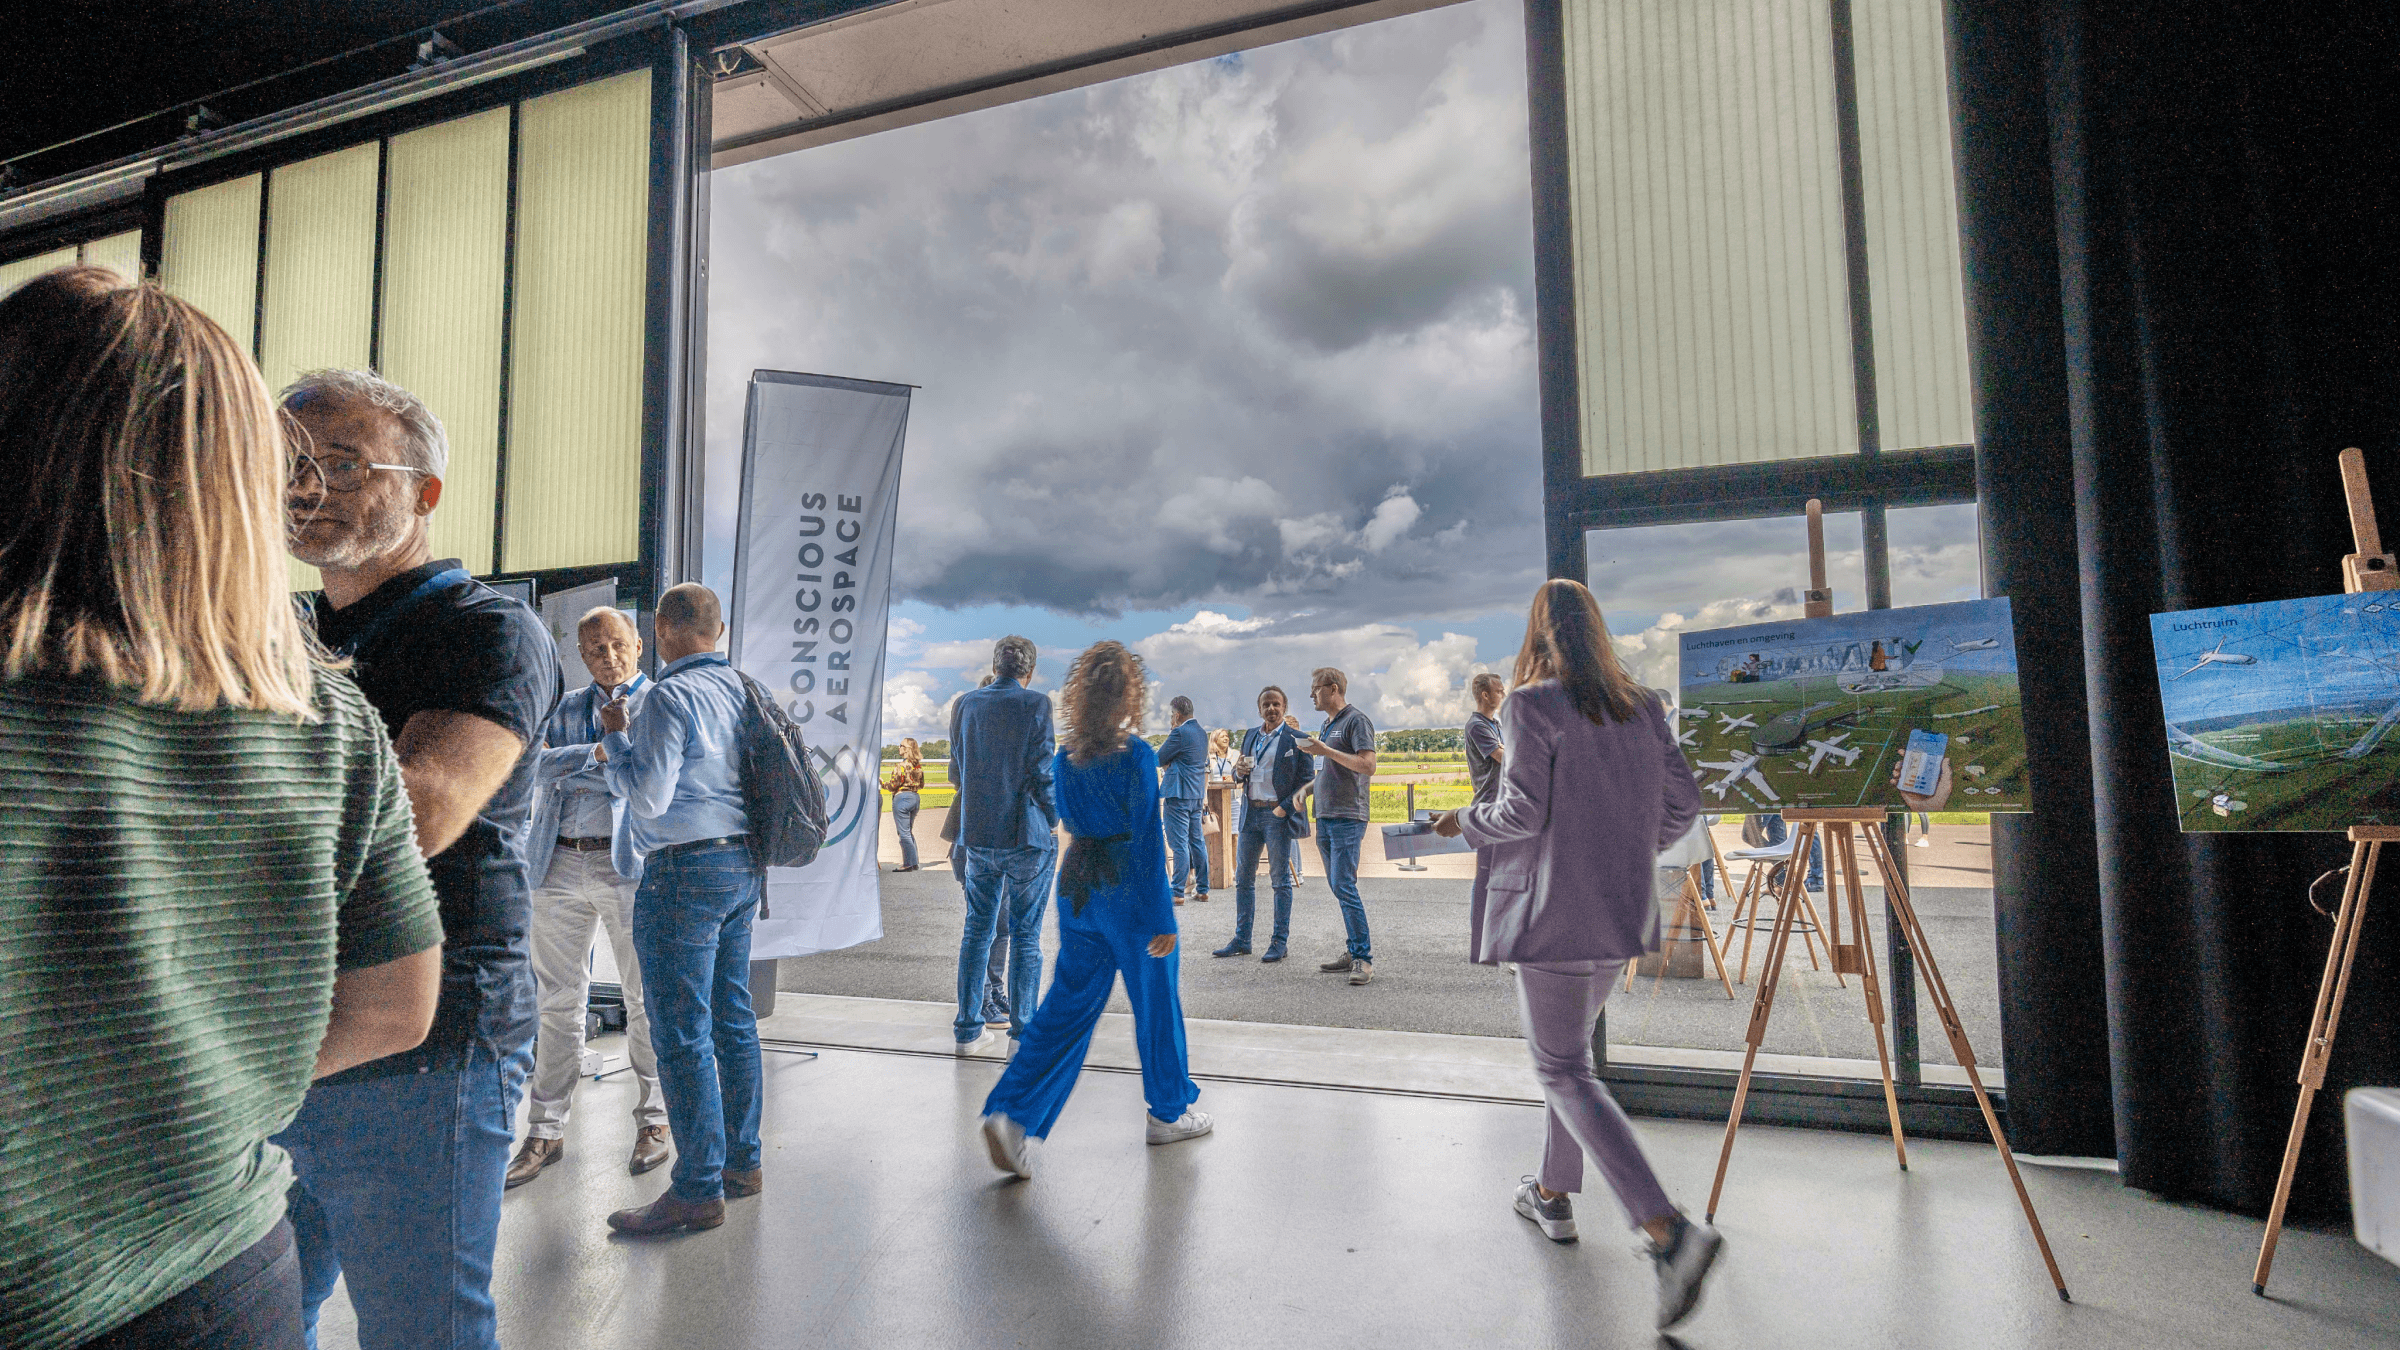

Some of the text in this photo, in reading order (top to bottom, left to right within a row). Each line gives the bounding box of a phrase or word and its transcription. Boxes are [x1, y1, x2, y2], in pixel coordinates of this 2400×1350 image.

[787, 492, 827, 724] CONSCIOUS
[825, 493, 862, 725] AEROSPACE
[1686, 631, 1796, 651] Luchthaven en omgeving
[2172, 618, 2239, 632] Luchtruim
